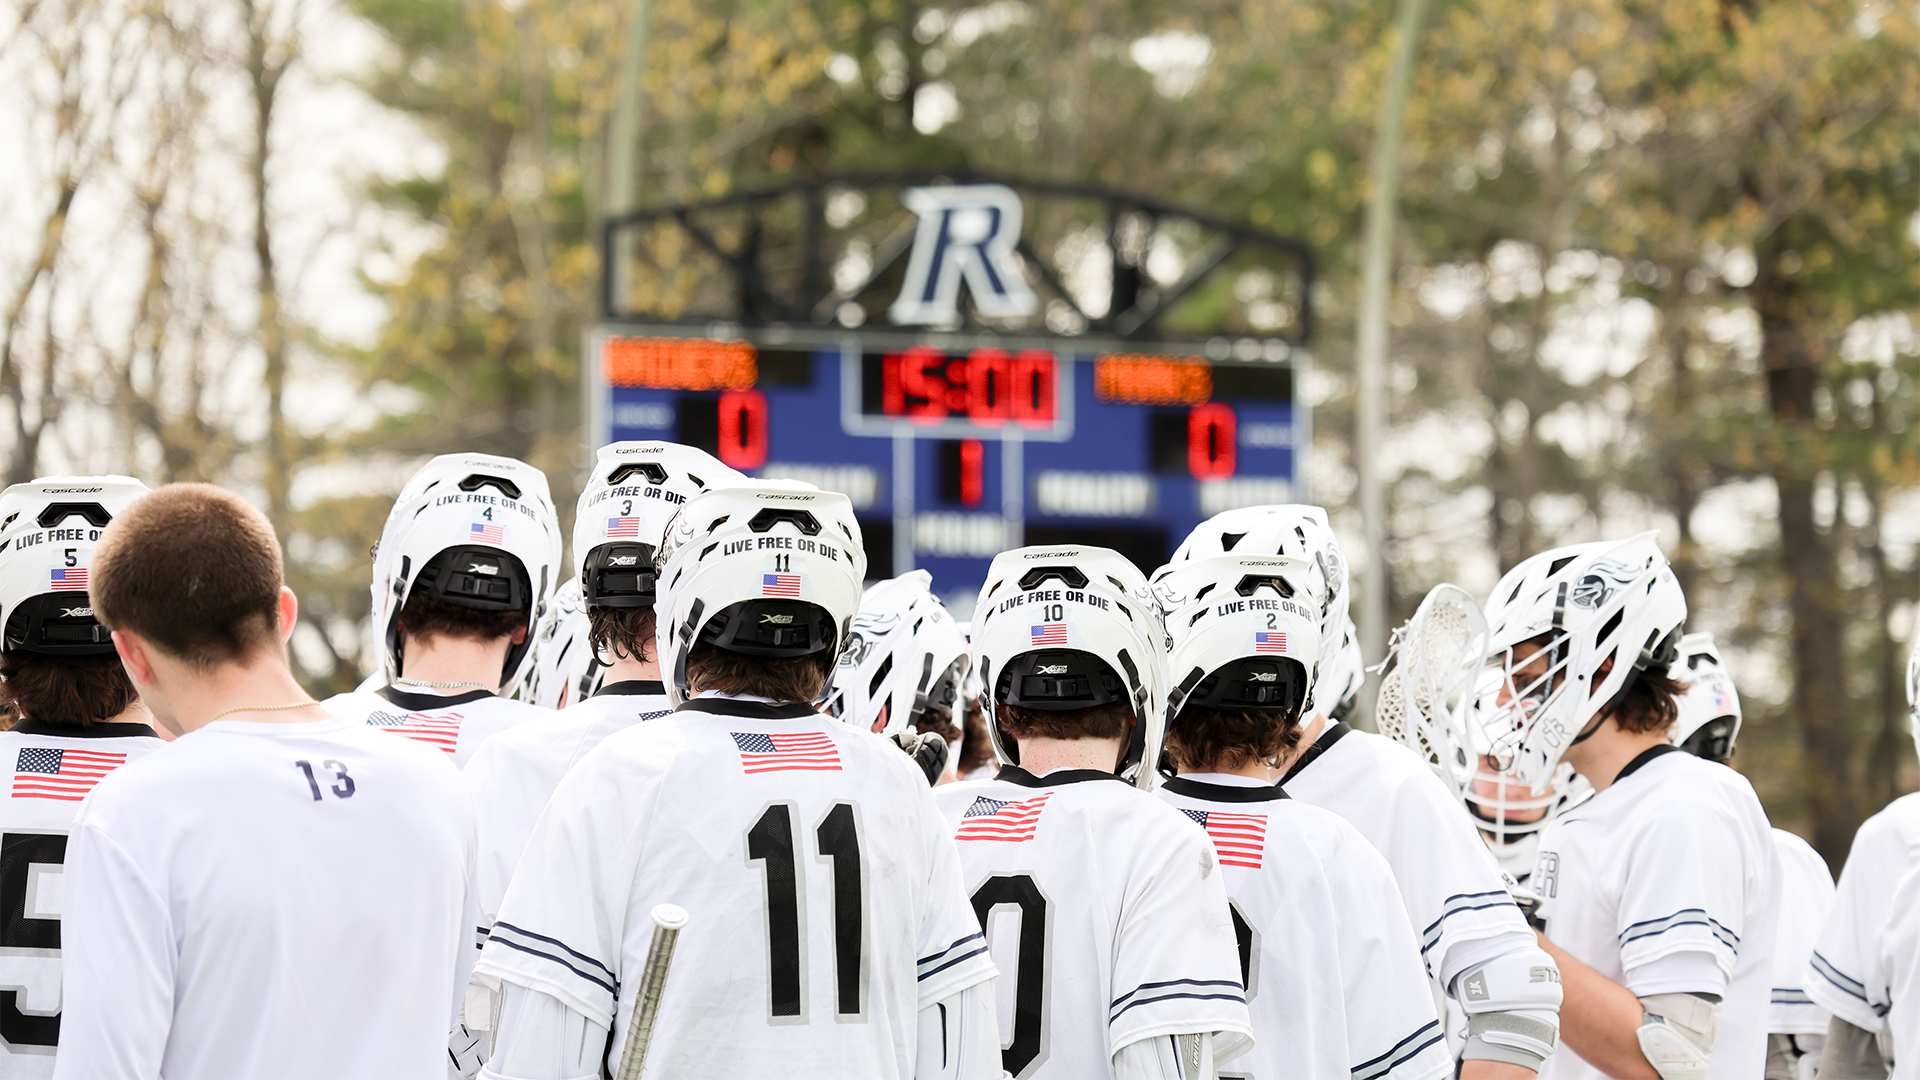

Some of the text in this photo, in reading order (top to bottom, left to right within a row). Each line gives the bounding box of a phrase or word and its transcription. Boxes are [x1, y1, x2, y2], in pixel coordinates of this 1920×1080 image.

[889, 183, 1039, 326] R
[882, 345, 1059, 428] 15:00
[717, 388, 768, 470] 0
[1187, 402, 1237, 482] 0
[960, 437, 984, 508] 1
[436, 494, 536, 521] LIVE FREE OR DIE
[588, 490, 608, 508] LIVE
[610, 486, 640, 498] FREE
[643, 486, 661, 499] OR
[620, 500, 633, 516] 3
[482, 507, 493, 521] 4
[15, 528, 101, 551] LIVE FREE O
[723, 537, 838, 562] LIVE FREE OR DIE
[64, 548, 77, 567] 5
[775, 553, 790, 572] 11
[1000, 590, 1109, 614] LIVE FREE OR DIE
[1043, 605, 1063, 622] 10
[1217, 599, 1312, 622] LIVE FREE OR DIE
[1266, 613, 1277, 630] 2
[295, 759, 356, 801] 13
[746, 802, 865, 1020] 11
[0, 830, 70, 1050] 5
